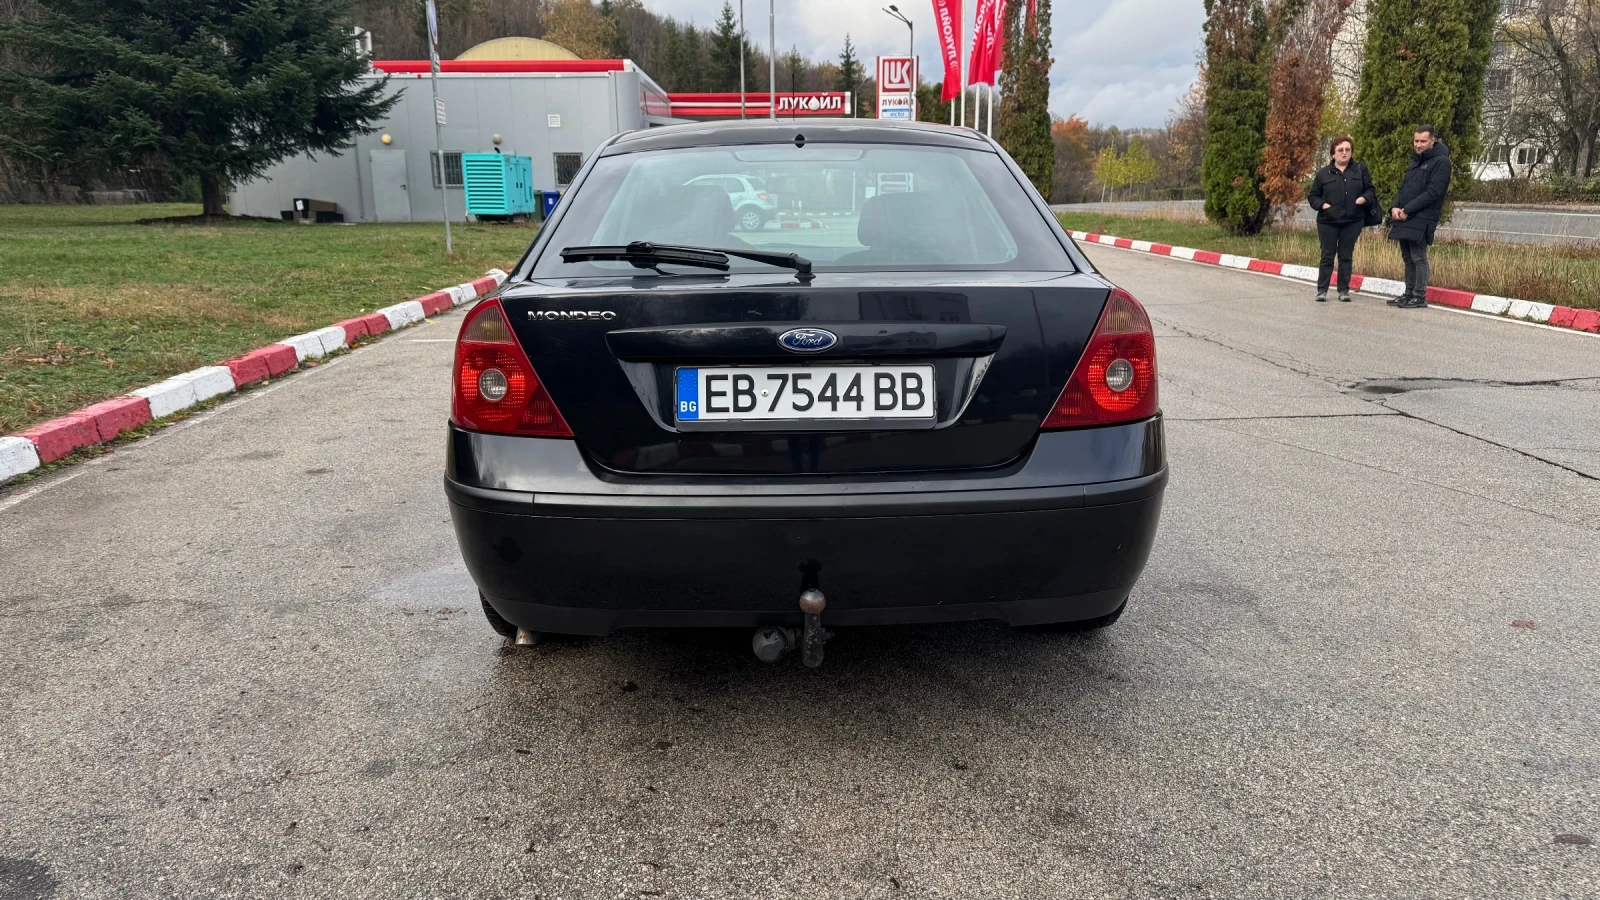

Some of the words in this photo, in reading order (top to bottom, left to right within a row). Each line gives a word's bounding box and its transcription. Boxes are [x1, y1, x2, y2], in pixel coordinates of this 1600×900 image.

[778, 92, 841, 111] ЛУКОЙЛ
[527, 310, 617, 321] MONDEO
[792, 332, 823, 346] Ford
[766, 372, 864, 412] 7544
[680, 401, 697, 413] BG
